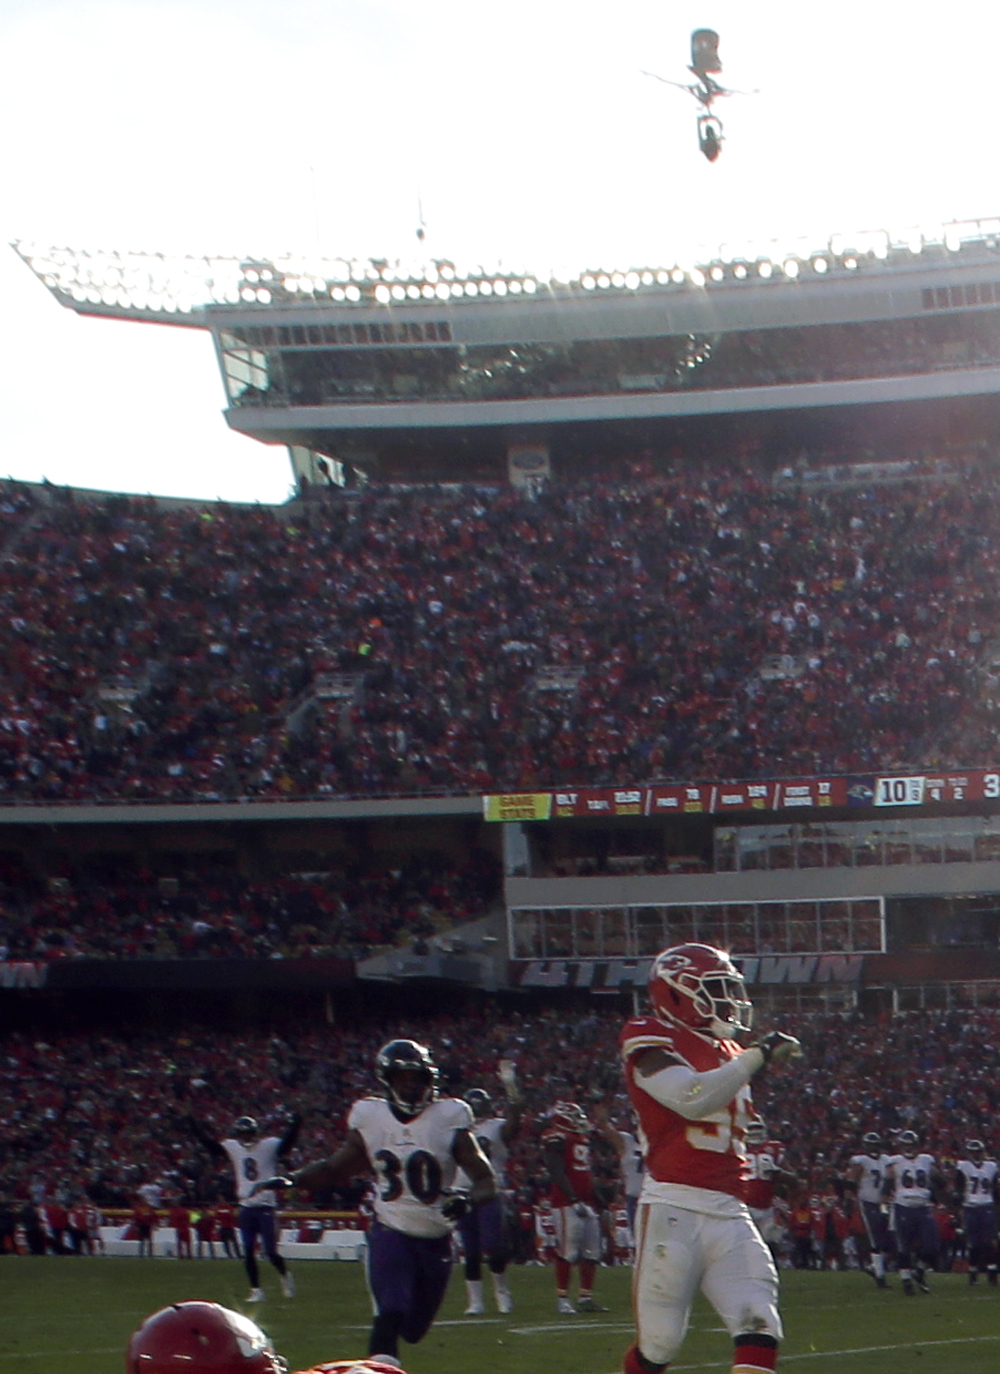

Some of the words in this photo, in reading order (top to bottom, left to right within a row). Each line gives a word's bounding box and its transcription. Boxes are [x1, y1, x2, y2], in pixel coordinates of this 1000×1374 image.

[881, 780, 907, 803] 10
[244, 1157, 257, 1180] 8
[373, 1149, 441, 1204] 30
